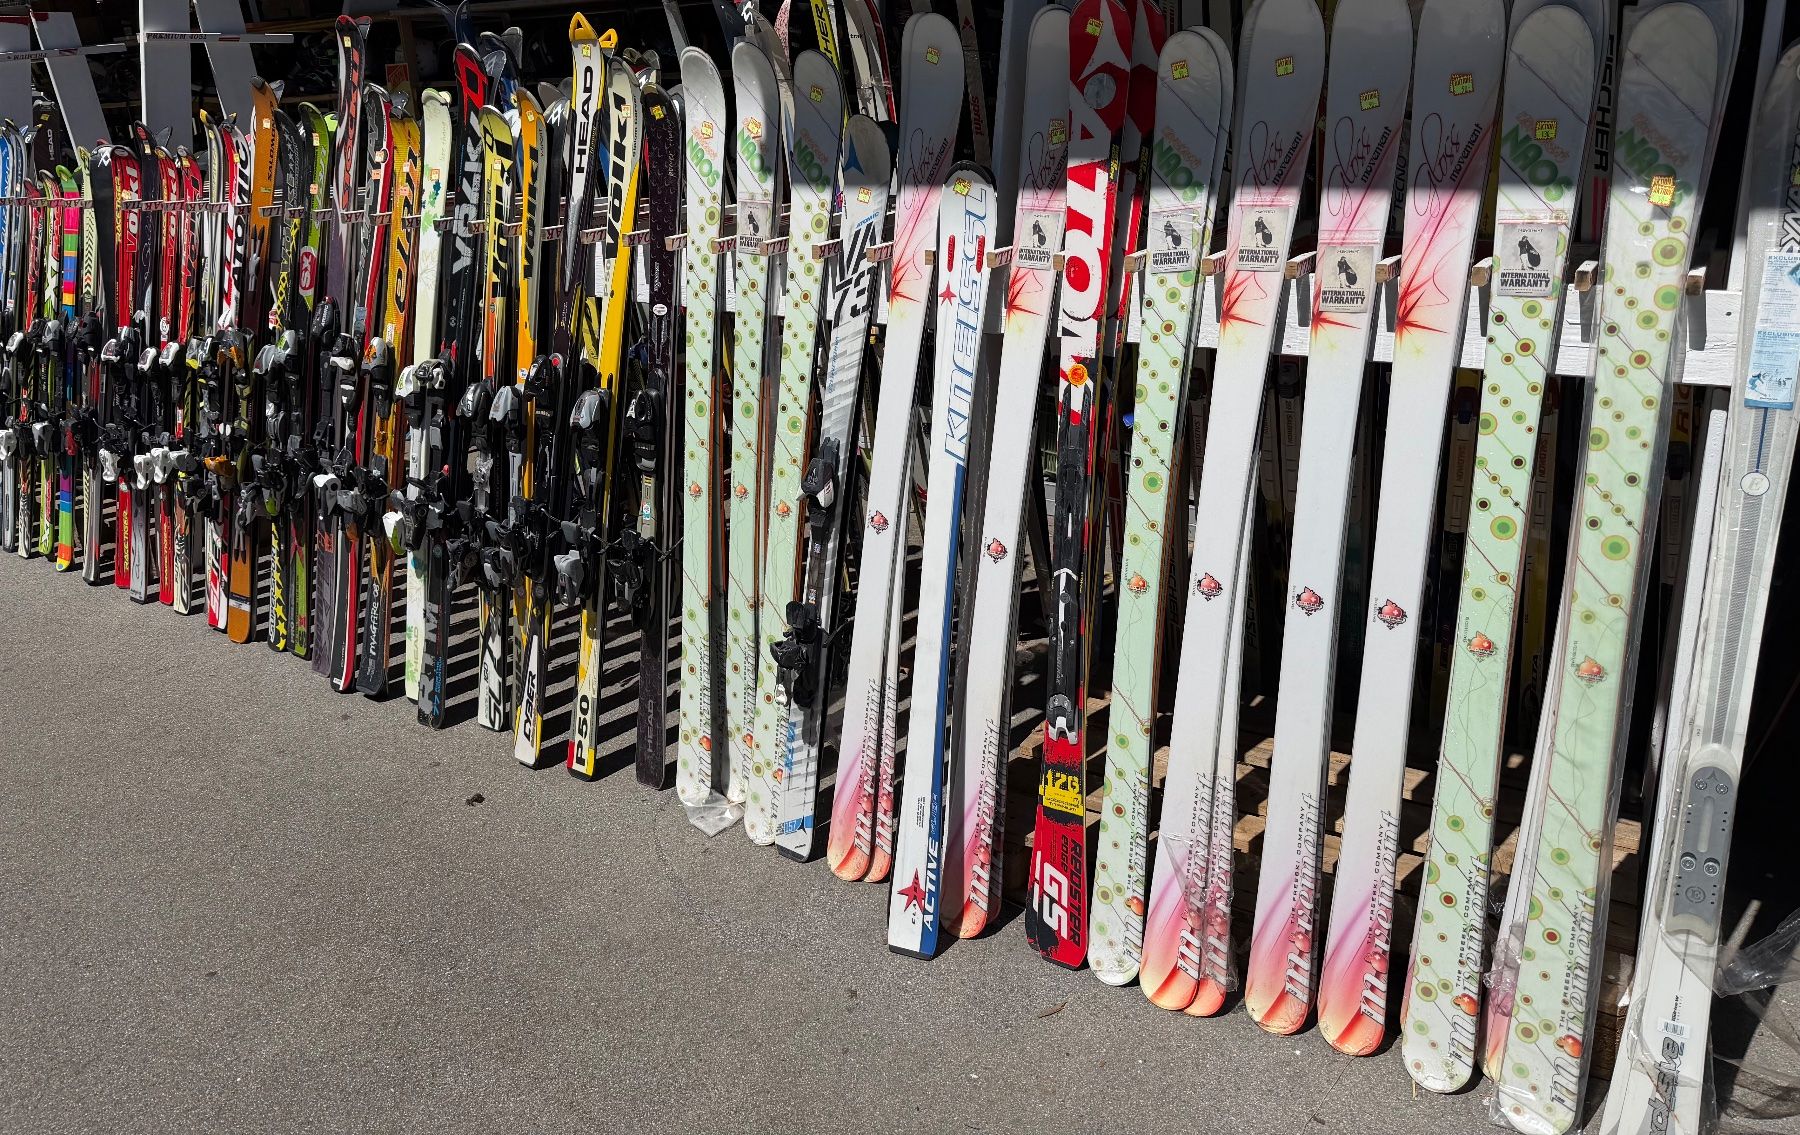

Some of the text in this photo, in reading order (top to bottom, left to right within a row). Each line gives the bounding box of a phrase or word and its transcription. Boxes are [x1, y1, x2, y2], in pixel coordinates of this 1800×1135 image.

[576, 66, 594, 174] HEAD
[971, 95, 984, 137] sprint
[927, 138, 951, 184] movement
[1272, 131, 1303, 185] movement
[1361, 126, 1392, 184] movement
[1450, 123, 1483, 183] movement
[855, 210, 880, 229] ATOMIC
[1019, 254, 1051, 263] WARRANTY
[1152, 256, 1191, 266] WARRANTY
[1153, 251, 1190, 259] INTERNATIONAL
[1238, 249, 1279, 257] INTERNATIONAL
[1238, 255, 1280, 264] WARRANTY
[1500, 272, 1550, 280] INTERNATIONAL
[1321, 296, 1366, 305] WARRANTY
[1322, 290, 1366, 298] INTERNATIONAL
[1500, 278, 1550, 288] WARRANTY
[524, 670, 537, 742] CYBER
[1190, 785, 1200, 833] COMPANY
[1293, 859, 1301, 902] FREESKI
[1297, 806, 1305, 855] COMPANY
[1369, 879, 1378, 921] FREESKI
[1374, 824, 1384, 874] COMPANY
[924, 837, 941, 932] ACTIVE
[1042, 861, 1069, 940] GS
[1463, 868, 1473, 918] COMPANY
[1568, 904, 1579, 956] COMPANY
